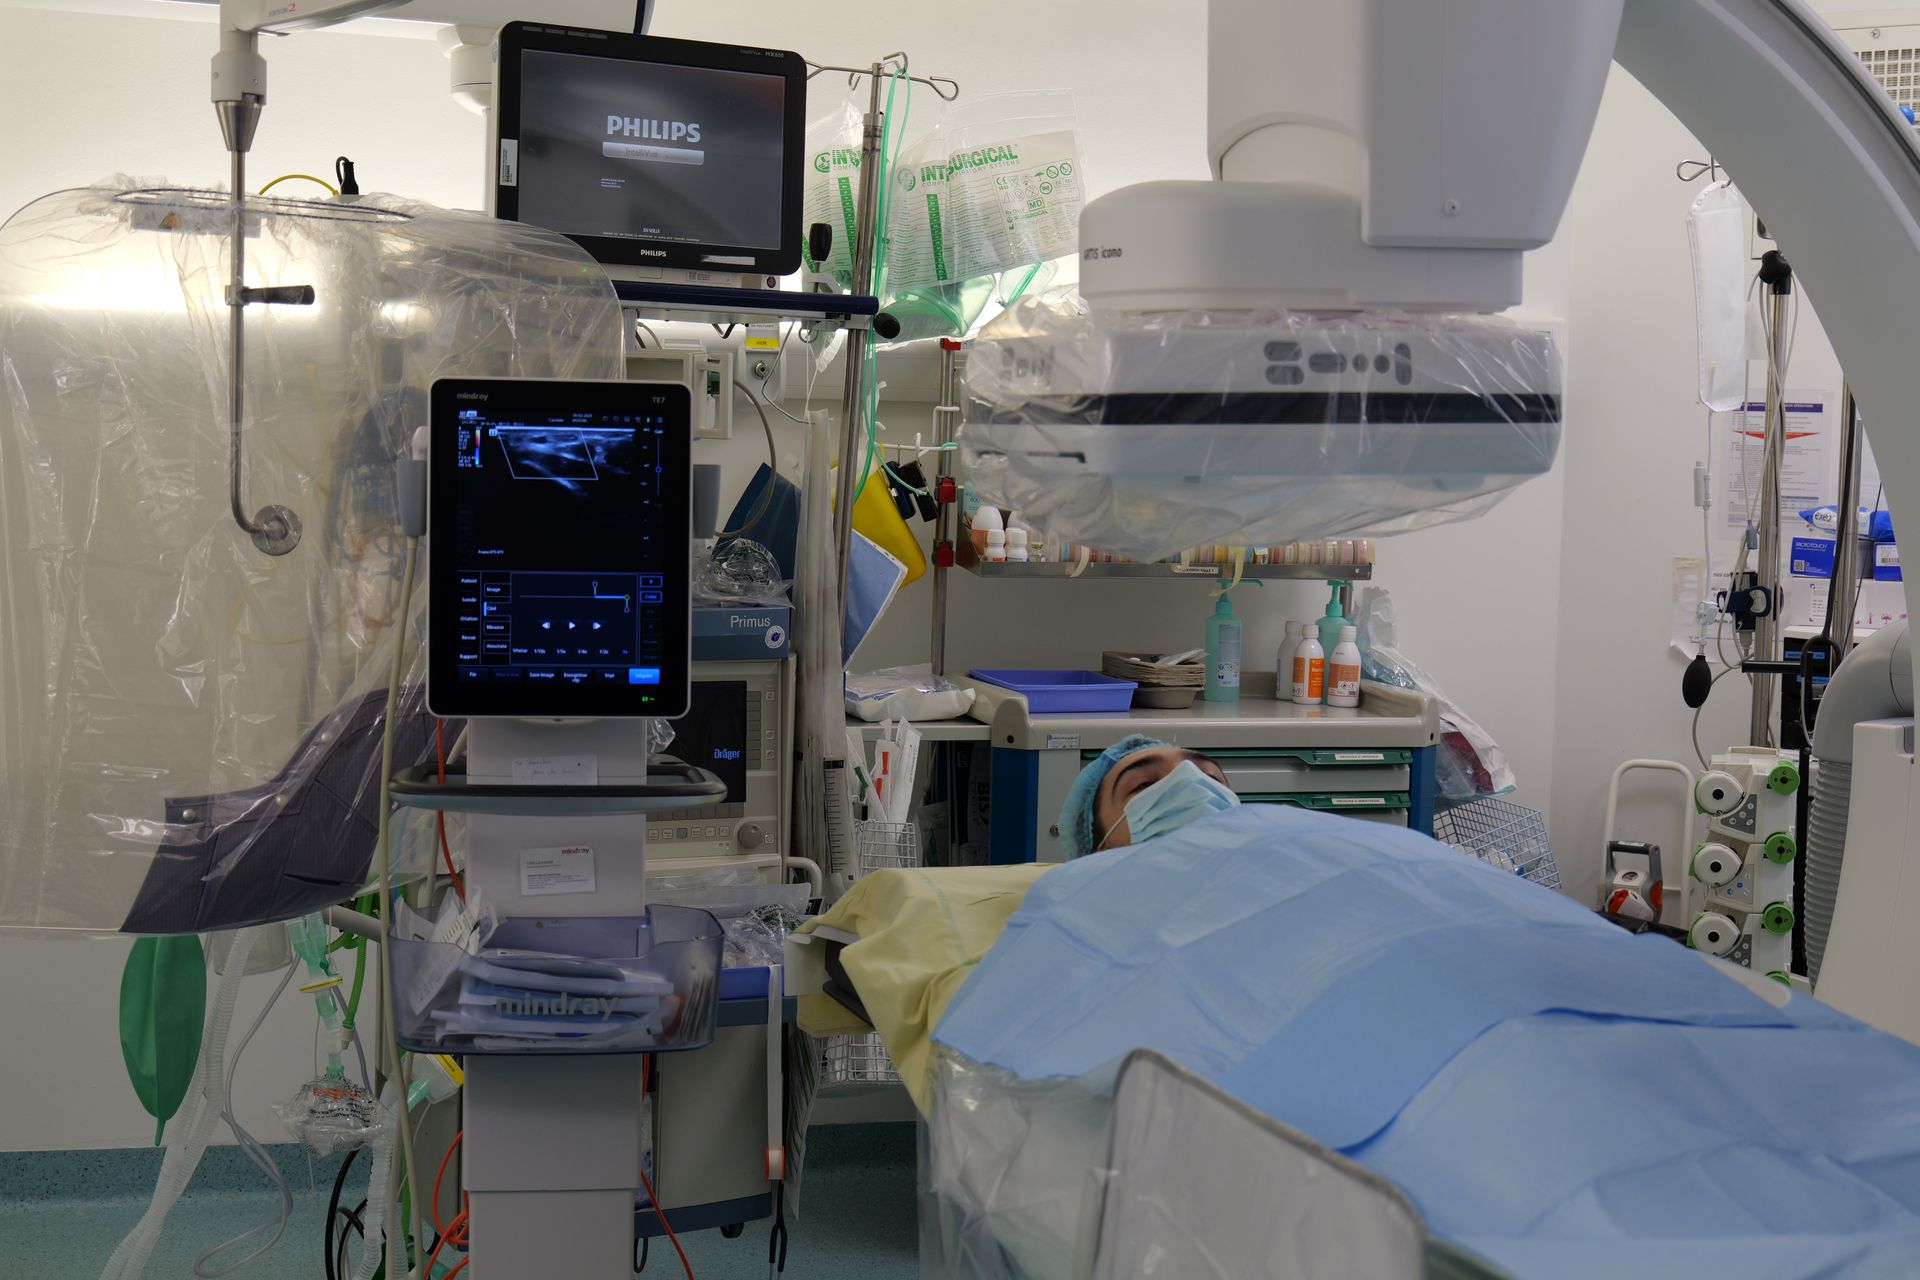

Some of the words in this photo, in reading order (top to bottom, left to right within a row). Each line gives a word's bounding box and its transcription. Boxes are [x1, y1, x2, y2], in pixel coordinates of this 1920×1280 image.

[607, 115, 701, 142] PHILIPS
[1029, 199, 1043, 210] MD
[640, 249, 667, 258] PHILIPS
[1101, 245, 1122, 258] icono
[456, 392, 488, 401] mindray
[652, 396, 665, 404] TE7
[730, 615, 771, 628] Primus
[714, 748, 741, 760] Dräger
[977, 782, 990, 815] BIS
[561, 847, 590, 855] mindray
[495, 991, 620, 1021] mindray
